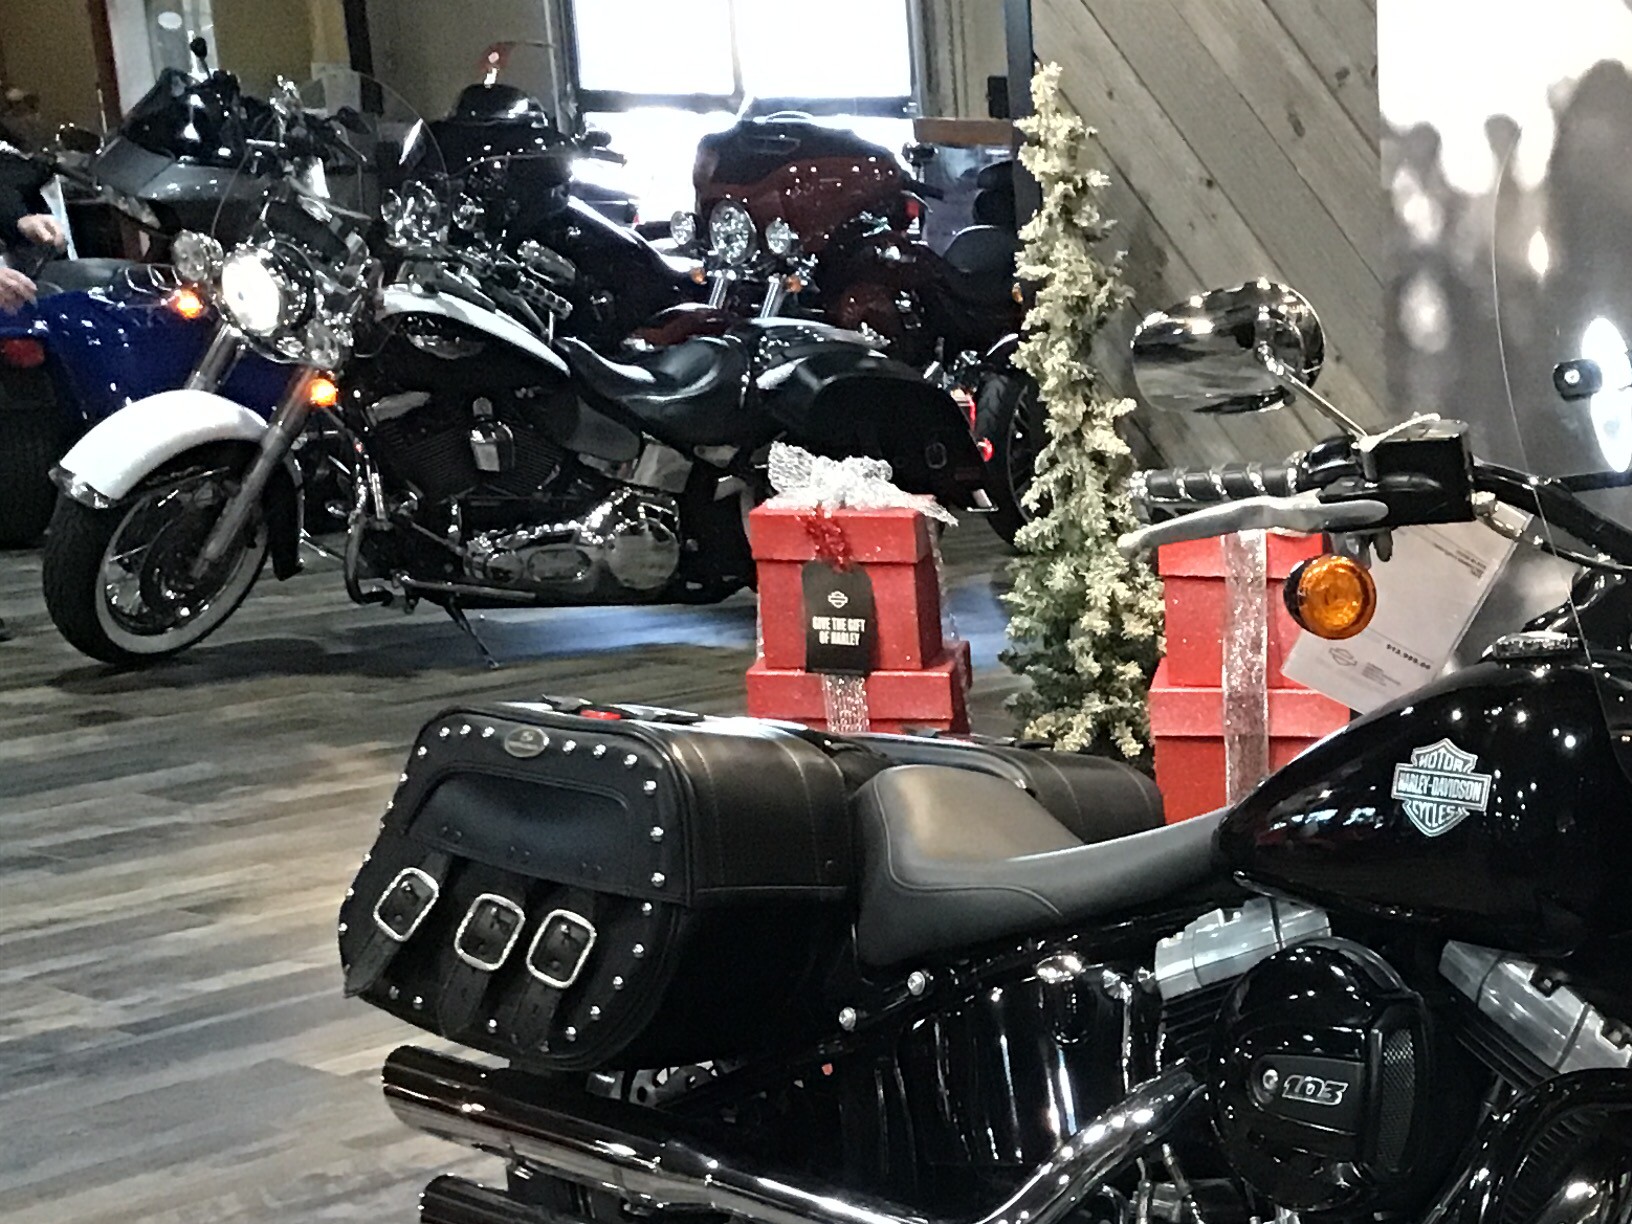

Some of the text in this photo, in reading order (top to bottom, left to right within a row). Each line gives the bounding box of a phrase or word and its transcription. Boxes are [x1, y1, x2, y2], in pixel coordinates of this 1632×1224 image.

[818, 630, 830, 645] OF
[831, 617, 847, 632] THE
[1418, 747, 1465, 773] MOTOR
[1397, 771, 1483, 802] HARLEY-DAVIDSON
[1412, 800, 1459, 828] CYCLES
[1282, 1074, 1349, 1106] 103
